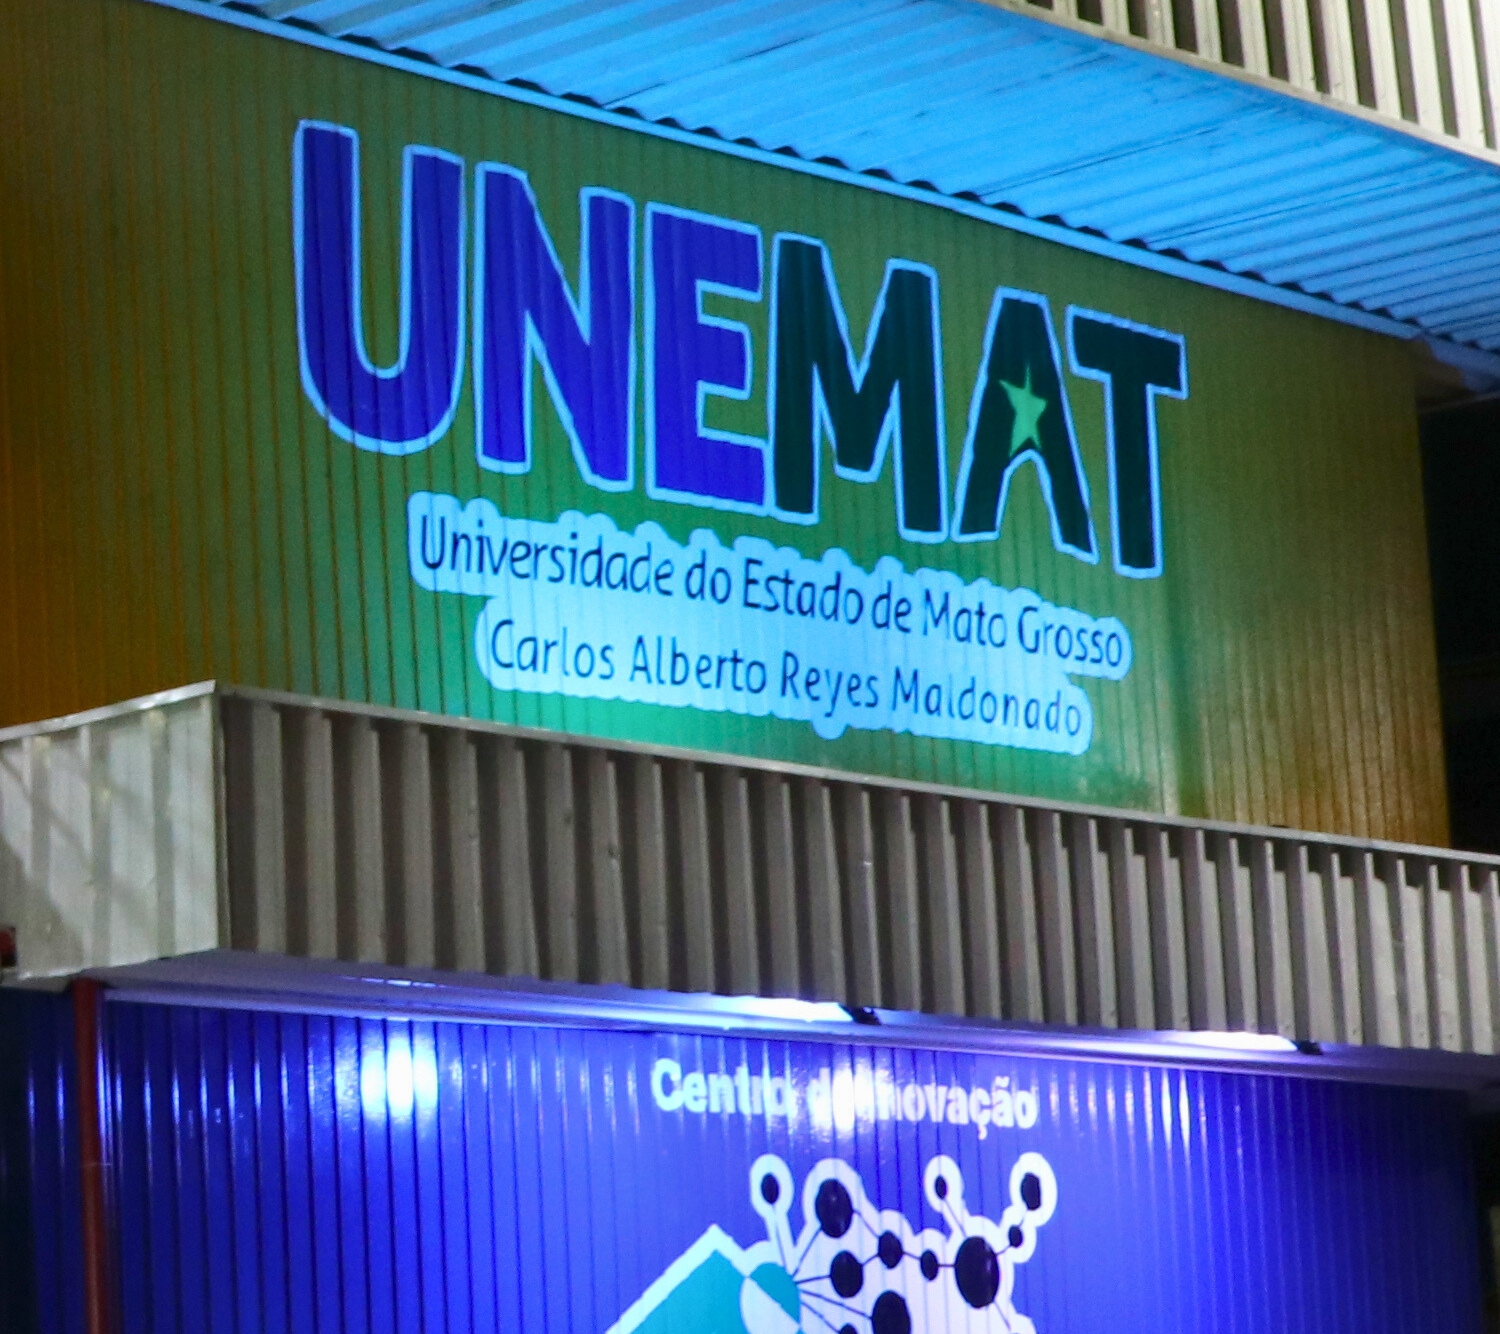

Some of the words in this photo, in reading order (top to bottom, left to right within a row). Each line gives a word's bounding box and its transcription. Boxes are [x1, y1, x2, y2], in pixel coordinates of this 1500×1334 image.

[293, 119, 1188, 579] UNEMAT
[420, 514, 675, 597] Universidade
[685, 548, 732, 605] do
[743, 557, 863, 625] Estado
[871, 580, 912, 634] de
[923, 587, 1007, 648] Mato
[1018, 605, 1123, 668] Grosso
[490, 618, 615, 681] Carlos
[629, 634, 767, 694] Alberto
[780, 650, 880, 718] Reyes
[892, 666, 1082, 737] Maldonado
[650, 1057, 792, 1117] Centro
